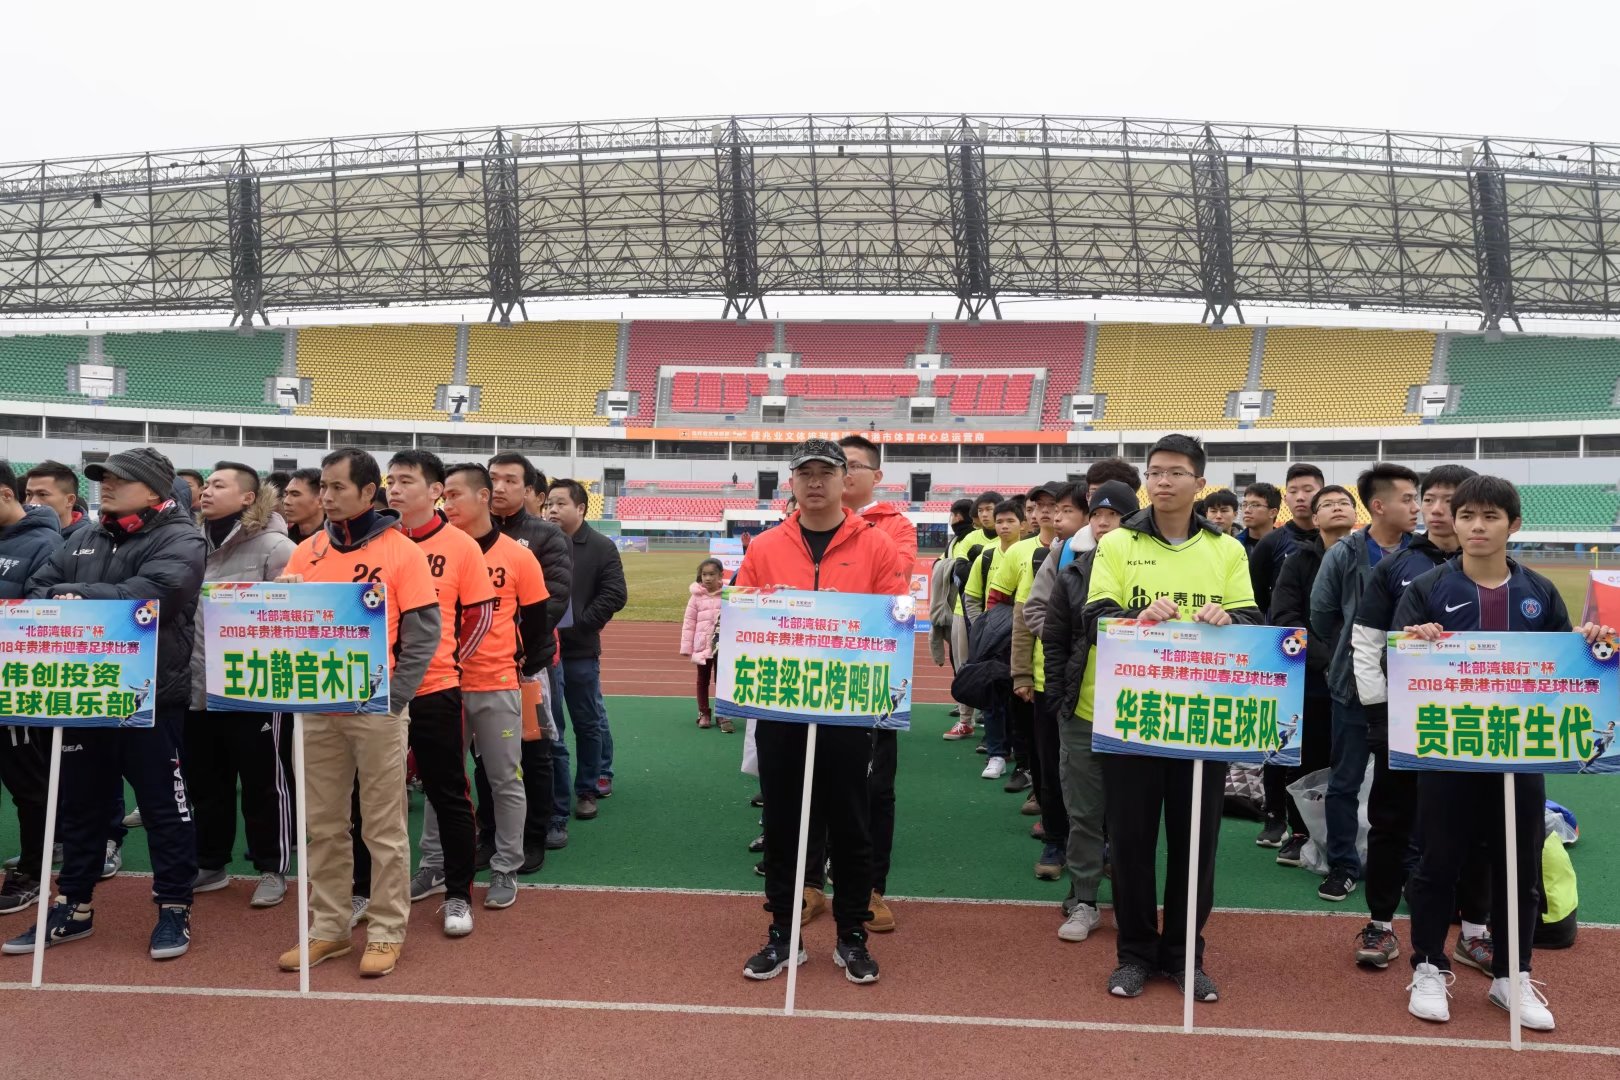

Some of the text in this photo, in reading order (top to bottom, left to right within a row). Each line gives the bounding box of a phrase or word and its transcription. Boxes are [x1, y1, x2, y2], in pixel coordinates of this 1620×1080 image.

[352, 563, 383, 582] 26
[220, 625, 371, 639] 2018年贵港市迎春足球比赛
[736, 631, 897, 652] 2018年贵港市迎春足球比赛
[0, 641, 140, 655] 18年贵港市迎春足球比赛
[2, 661, 121, 689] 伟创投资
[223, 650, 371, 701] 王力静音木门
[732, 654, 894, 717] 东津梁记烤鸭队
[1114, 663, 1288, 687] 2018年贵港市迎春足球比赛
[1407, 677, 1600, 694] 2018年贵港市迎春足球比赛
[1114, 688, 1281, 750] 华泰江南足球队
[1416, 703, 1594, 759] 贵高新生代
[61, 744, 83, 753] GEA
[173, 766, 192, 822] LEGEA
